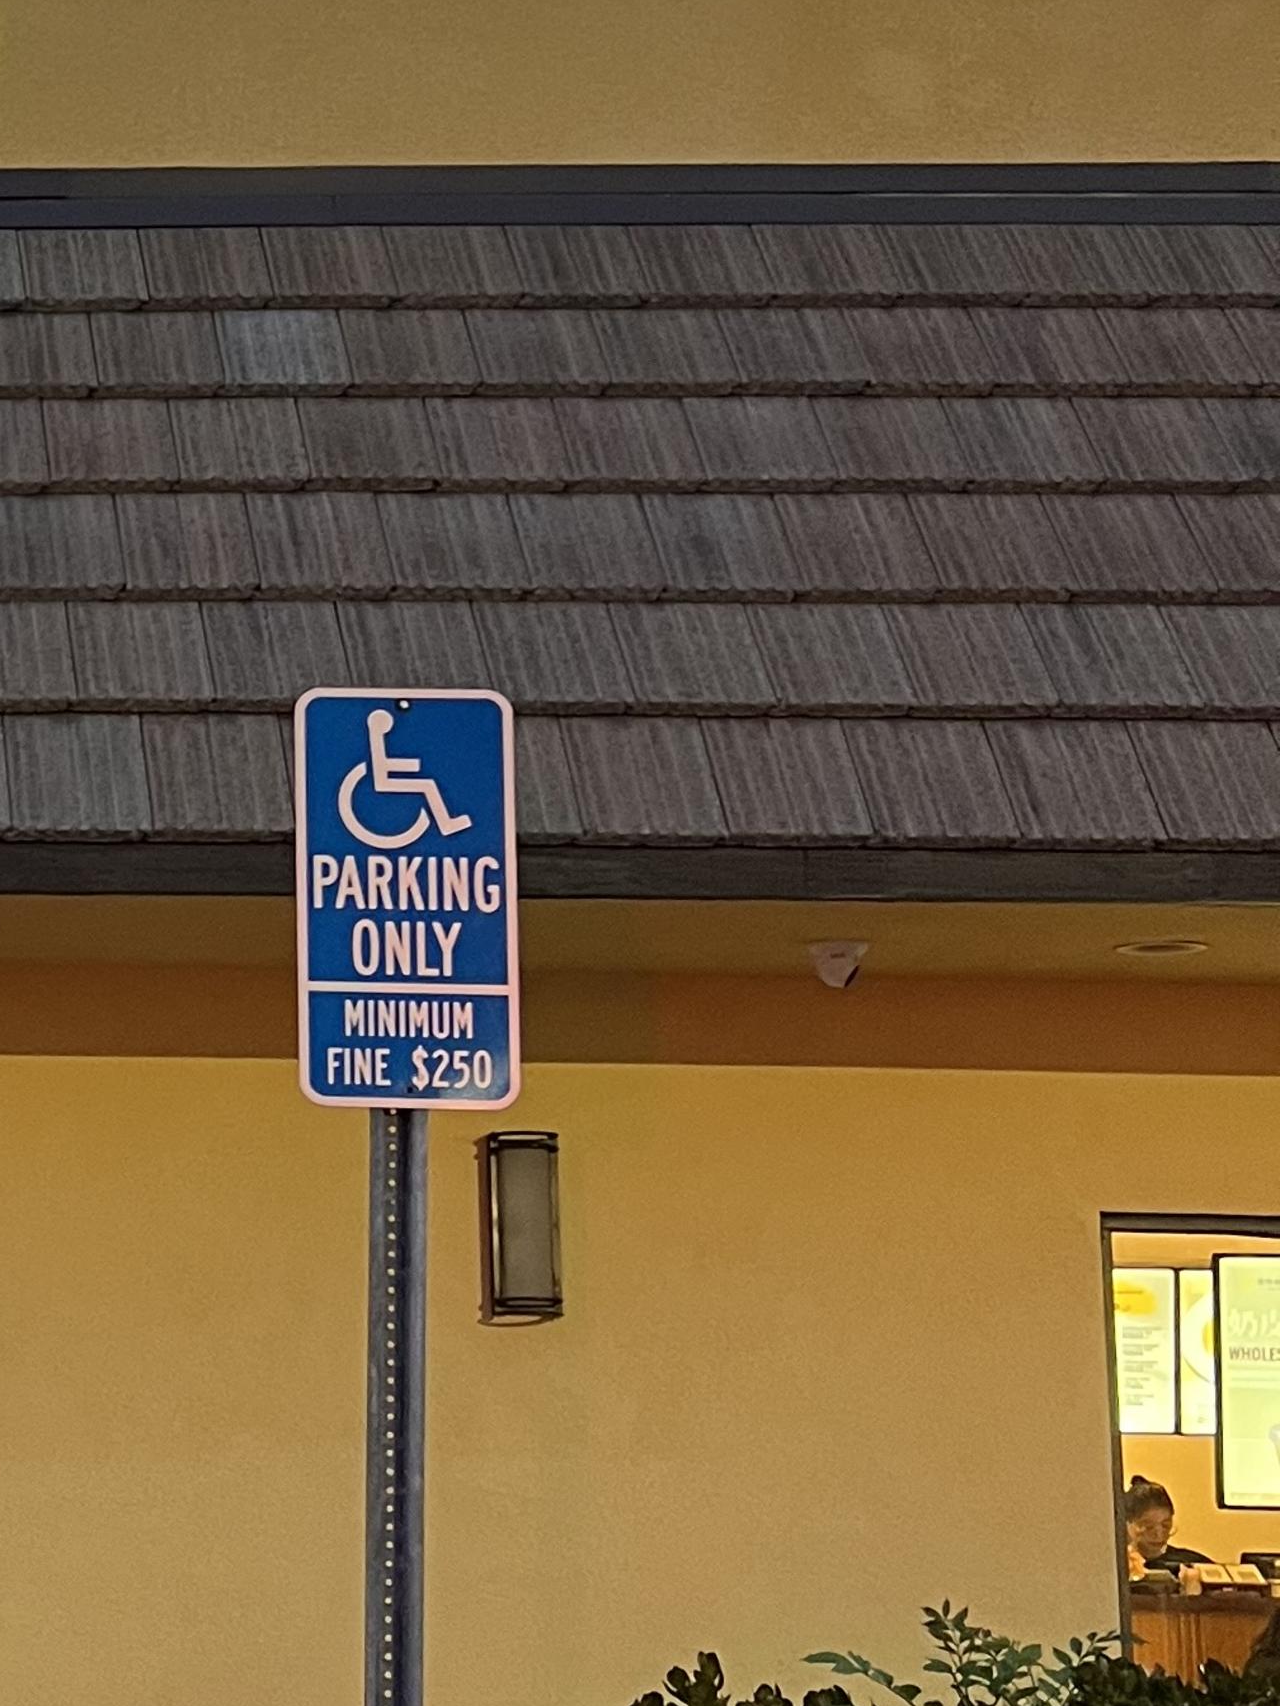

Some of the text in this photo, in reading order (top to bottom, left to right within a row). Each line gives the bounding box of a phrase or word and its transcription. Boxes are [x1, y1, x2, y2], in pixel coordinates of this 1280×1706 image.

[313, 854, 500, 913] PARKING
[352, 920, 462, 977] ONLY
[344, 999, 474, 1040] MINIMUM
[327, 1045, 492, 1090] FINE $250
